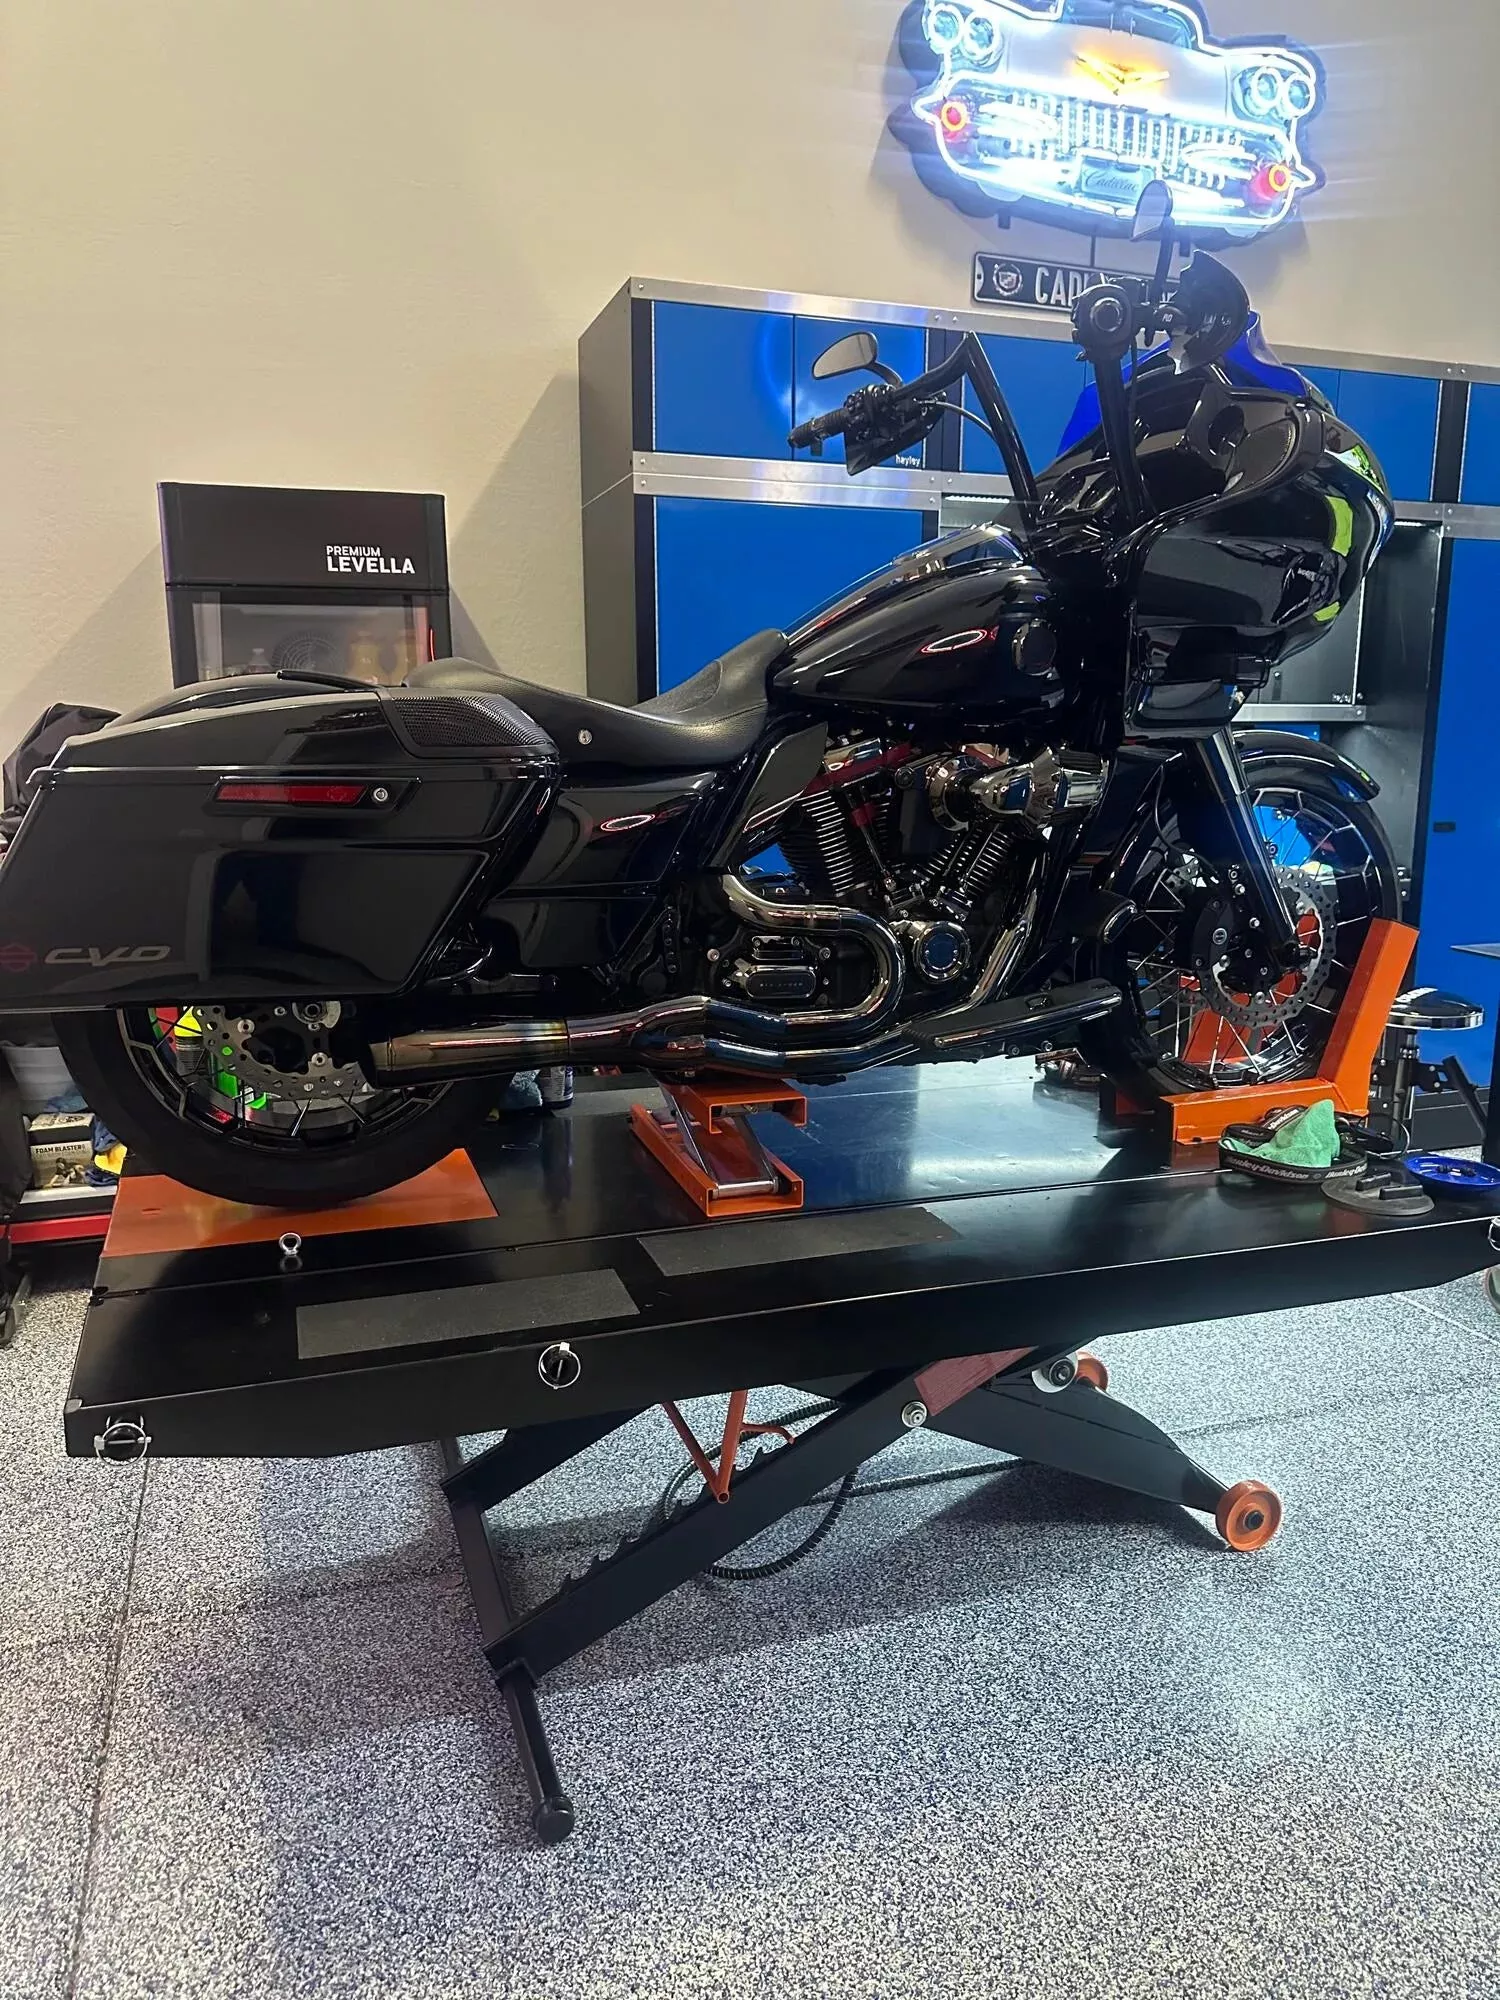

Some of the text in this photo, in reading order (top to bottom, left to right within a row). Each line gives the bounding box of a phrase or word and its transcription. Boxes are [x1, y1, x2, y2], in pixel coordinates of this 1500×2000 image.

[1085, 171, 1138, 192] Cadillac
[895, 454, 921, 468] hayley
[326, 545, 381, 557] PREMIUM
[327, 556, 416, 574] LEVELLA
[44, 945, 171, 967] CVO
